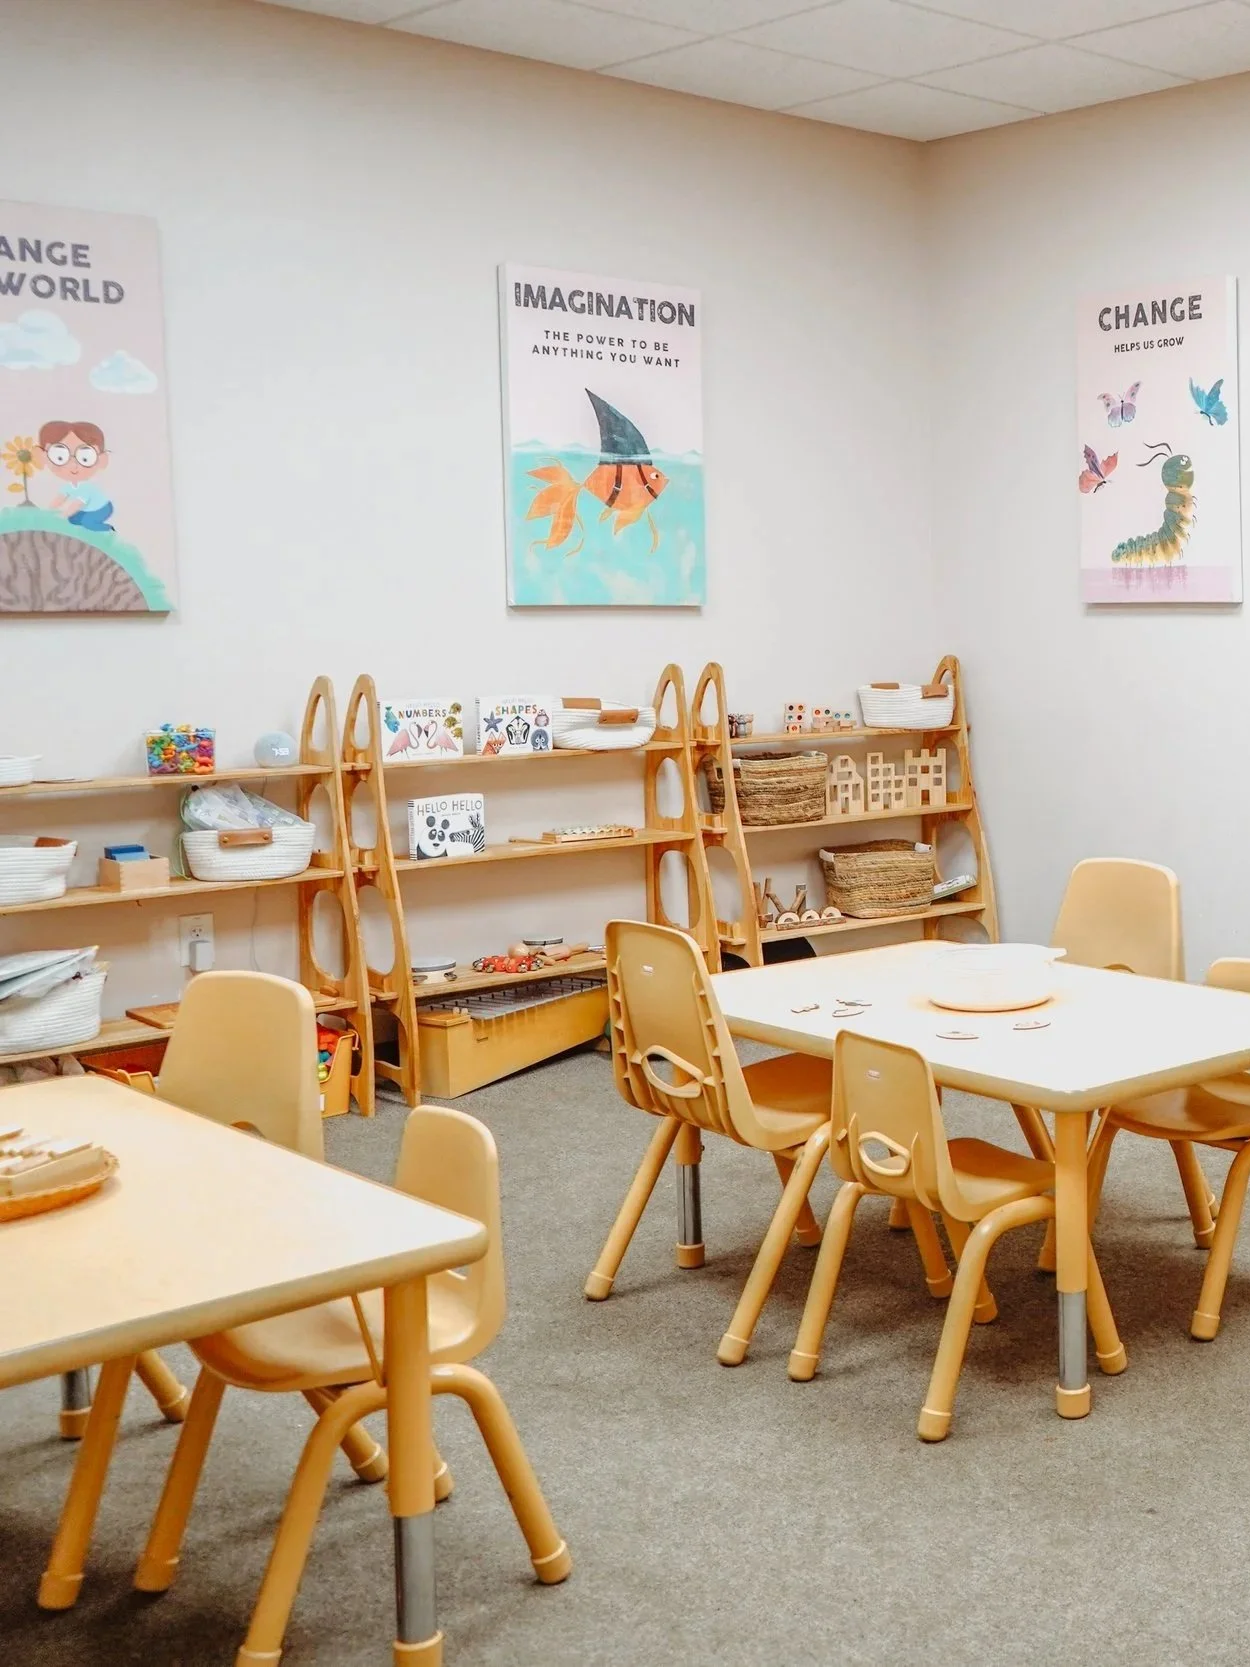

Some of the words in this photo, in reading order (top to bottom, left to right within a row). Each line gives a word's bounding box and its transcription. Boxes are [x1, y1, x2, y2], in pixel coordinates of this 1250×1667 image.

[0, 271, 125, 305] WORLD
[514, 282, 695, 327] IMAGINATION
[1098, 294, 1203, 332] CHANGE
[544, 330, 570, 341] THE
[577, 333, 624, 347] POWER
[632, 340, 647, 349] TO
[654, 342, 669, 352] BE
[1114, 341, 1140, 353] HELPS
[1143, 340, 1154, 349] US
[1157, 336, 1184, 348] GROW
[532, 345, 603, 361] ANYTHING
[610, 352, 636, 364] YOU
[643, 356, 680, 368] WANT
[398, 709, 447, 719] NUMBERS
[495, 704, 538, 716] SHAPES
[417, 801, 448, 816] HELLO
[452, 800, 482, 811] HELLO
